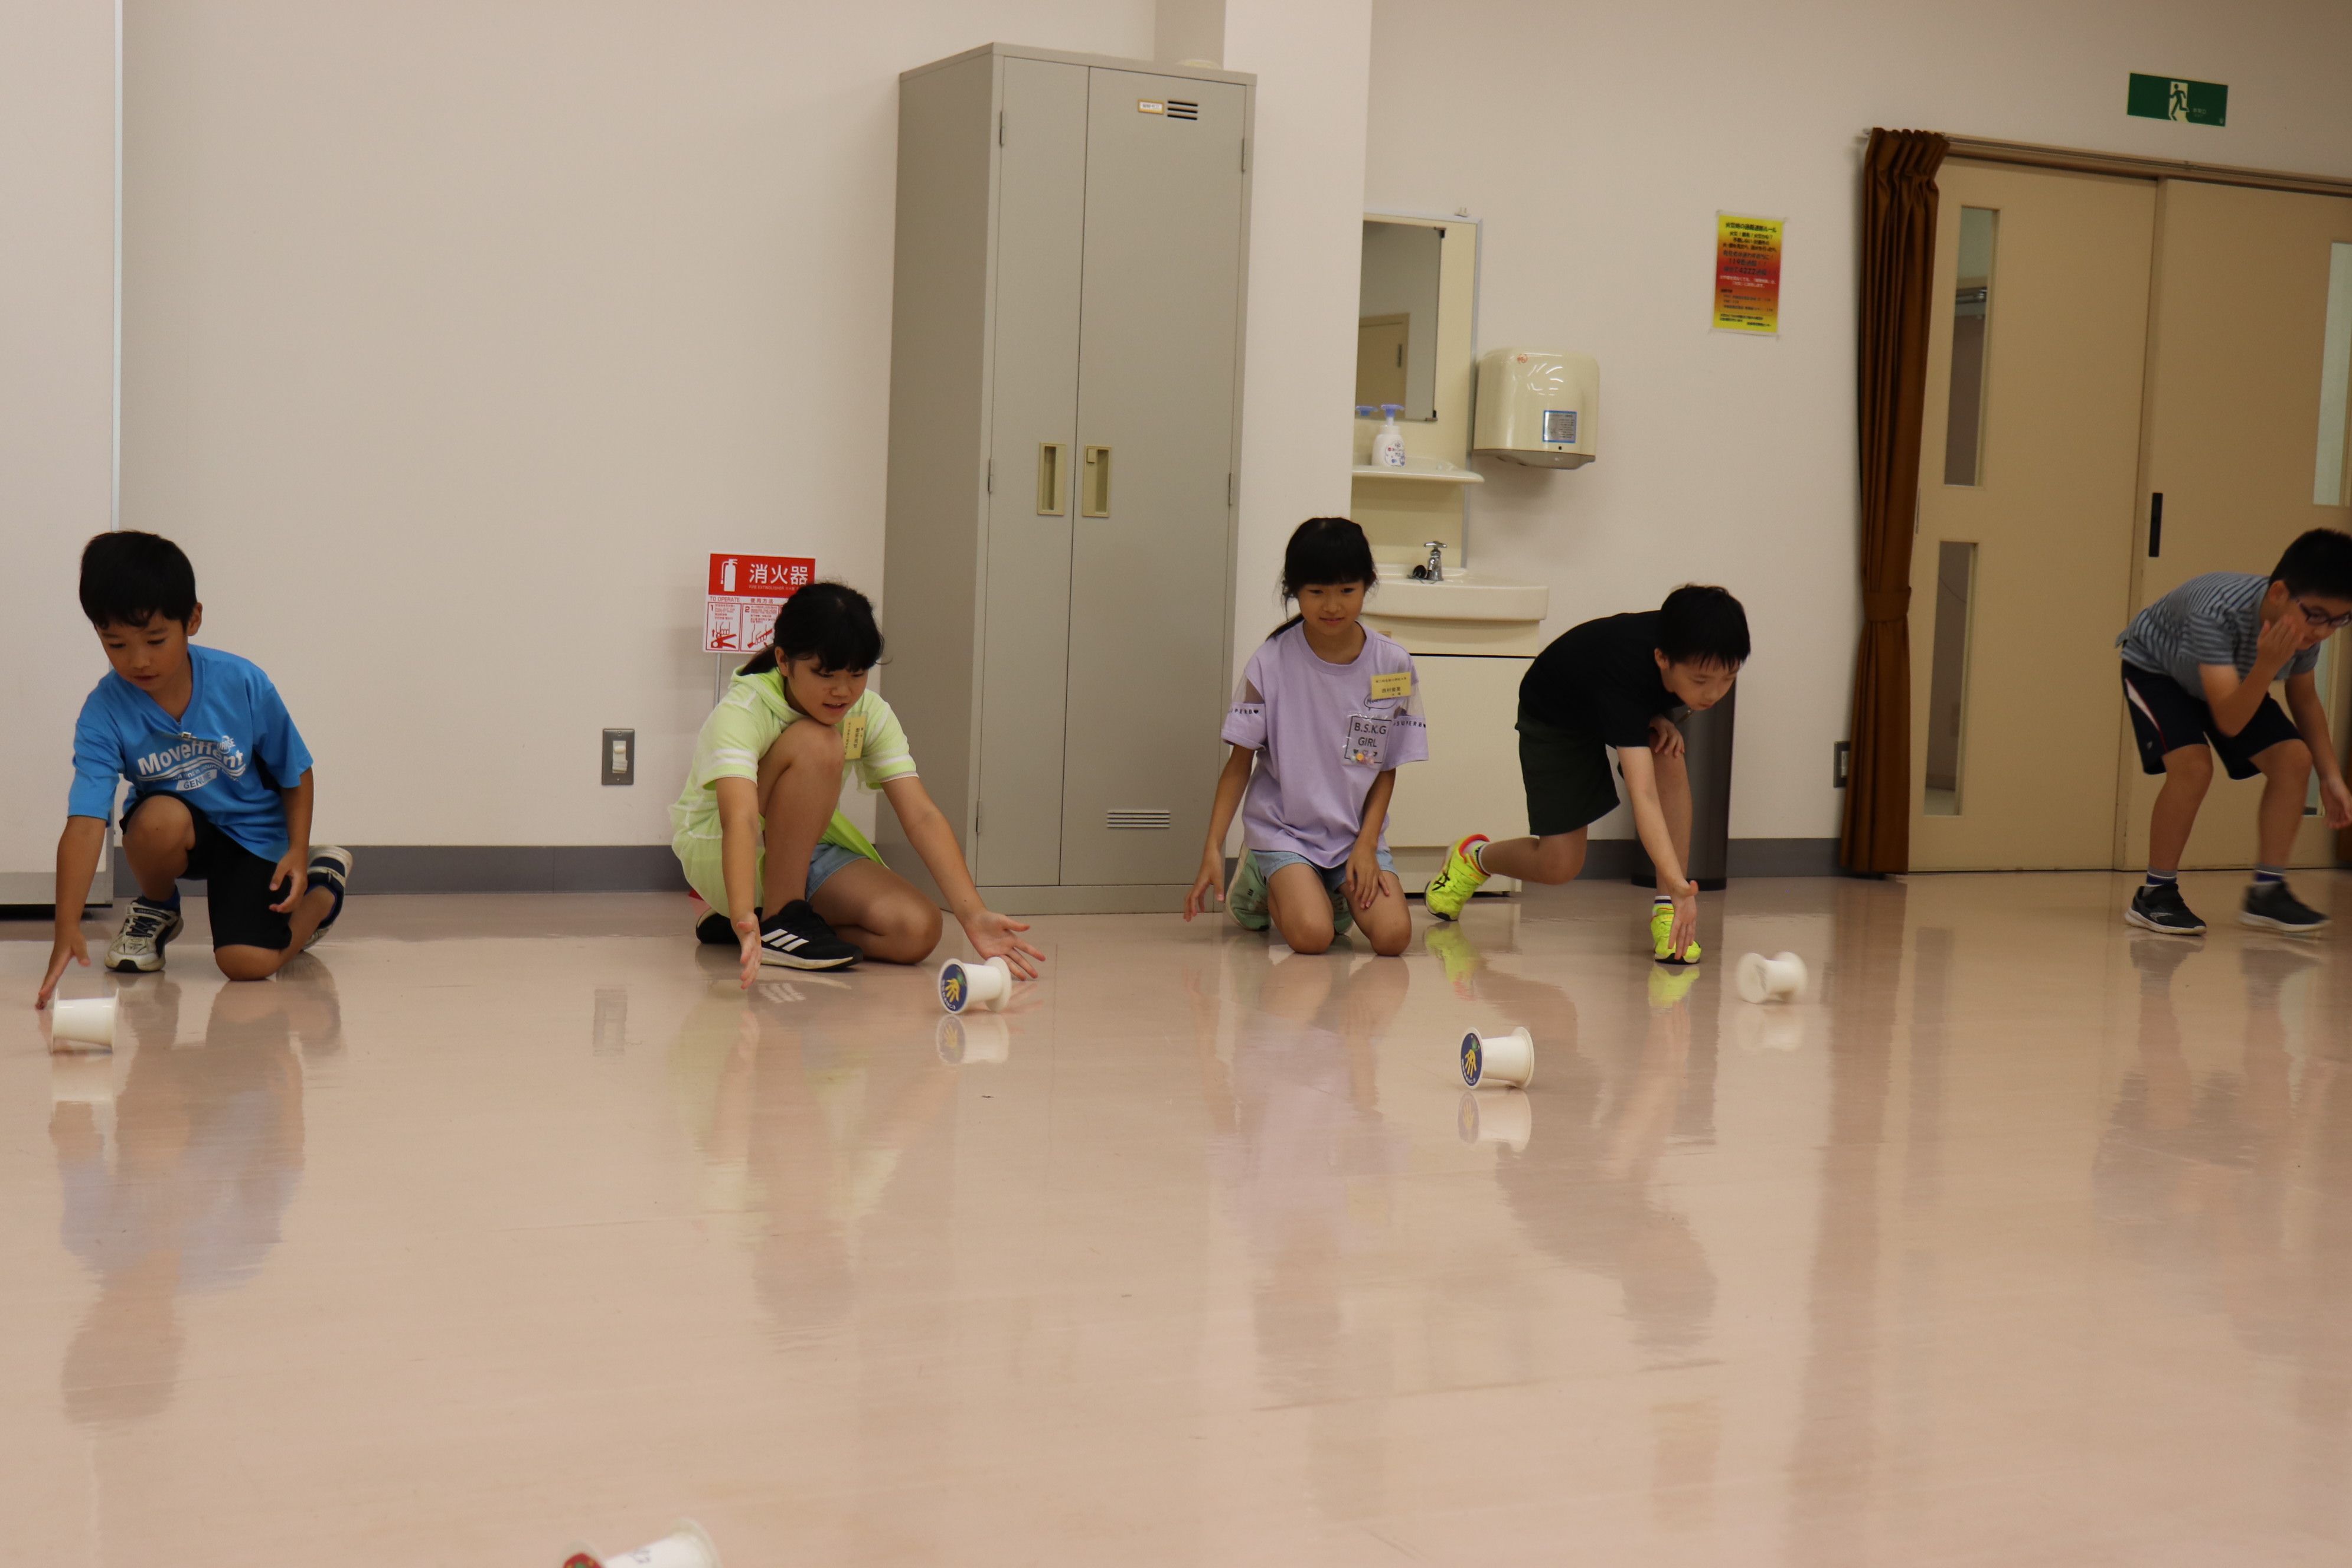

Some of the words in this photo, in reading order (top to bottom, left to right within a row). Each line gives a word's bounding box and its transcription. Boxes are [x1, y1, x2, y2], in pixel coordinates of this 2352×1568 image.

[749, 563, 808, 585] 消火器
[1358, 737, 1377, 748] GIRL
